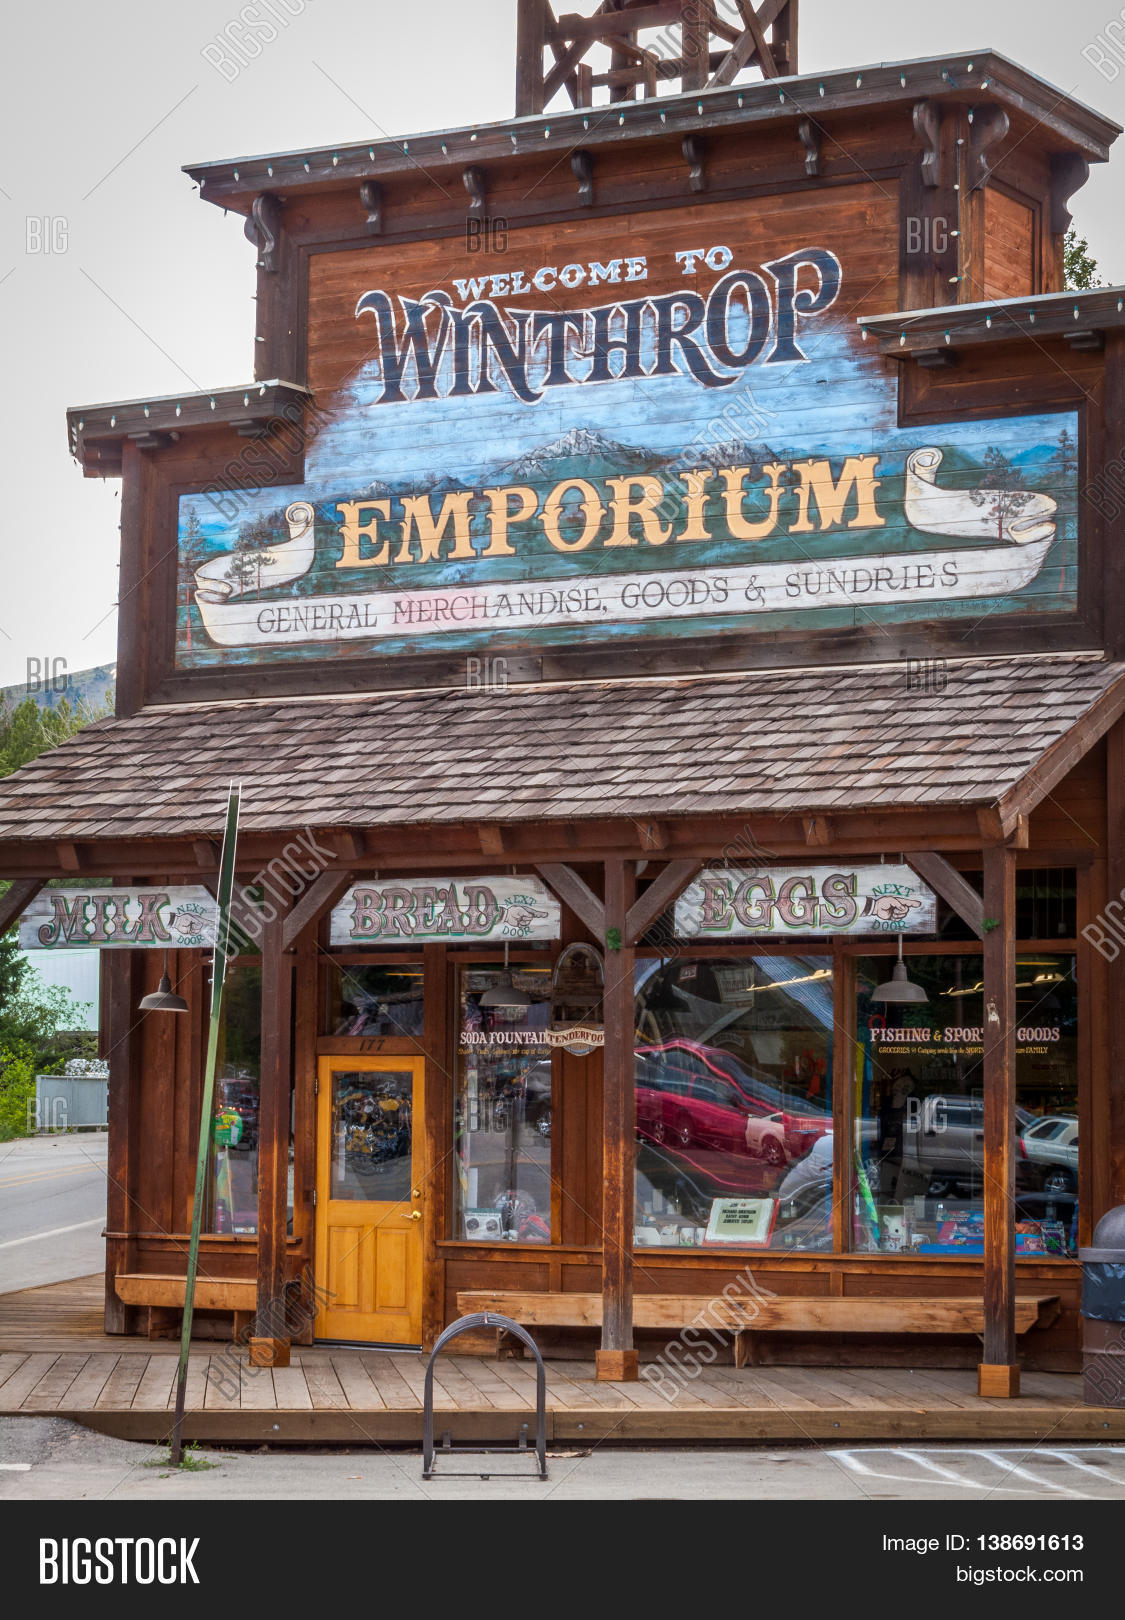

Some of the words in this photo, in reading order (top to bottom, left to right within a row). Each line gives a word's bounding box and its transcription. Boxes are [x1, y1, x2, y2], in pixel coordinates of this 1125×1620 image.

[453, 256, 648, 300] WELCOME
[676, 246, 733, 275] TO
[355, 247, 842, 406] WINTHROP
[335, 454, 886, 569] EMPORIUM
[256, 602, 378, 633] GENERAL
[391, 586, 608, 626] MERCHANDISE,
[621, 577, 729, 609] GOODS
[745, 574, 766, 607] &
[785, 562, 959, 598] SUNDRIES
[871, 883, 915, 898] NEXT
[504, 894, 537, 907] NEXT
[700, 873, 860, 931] EGGS
[177, 903, 208, 915] NEXT
[350, 881, 501, 939] BREAD
[38, 893, 173, 948] MILK
[872, 918, 910, 931] DOOR
[502, 925, 534, 938] DOOR
[176, 934, 206, 946] DOOR
[460, 1031, 487, 1045] SODA
[547, 1029, 605, 1044] TENDERFOO
[870, 1028, 931, 1042] FISHING
[933, 1030, 943, 1042] &
[944, 1027, 984, 1042] SPOR
[1017, 1027, 1060, 1042] GOODS
